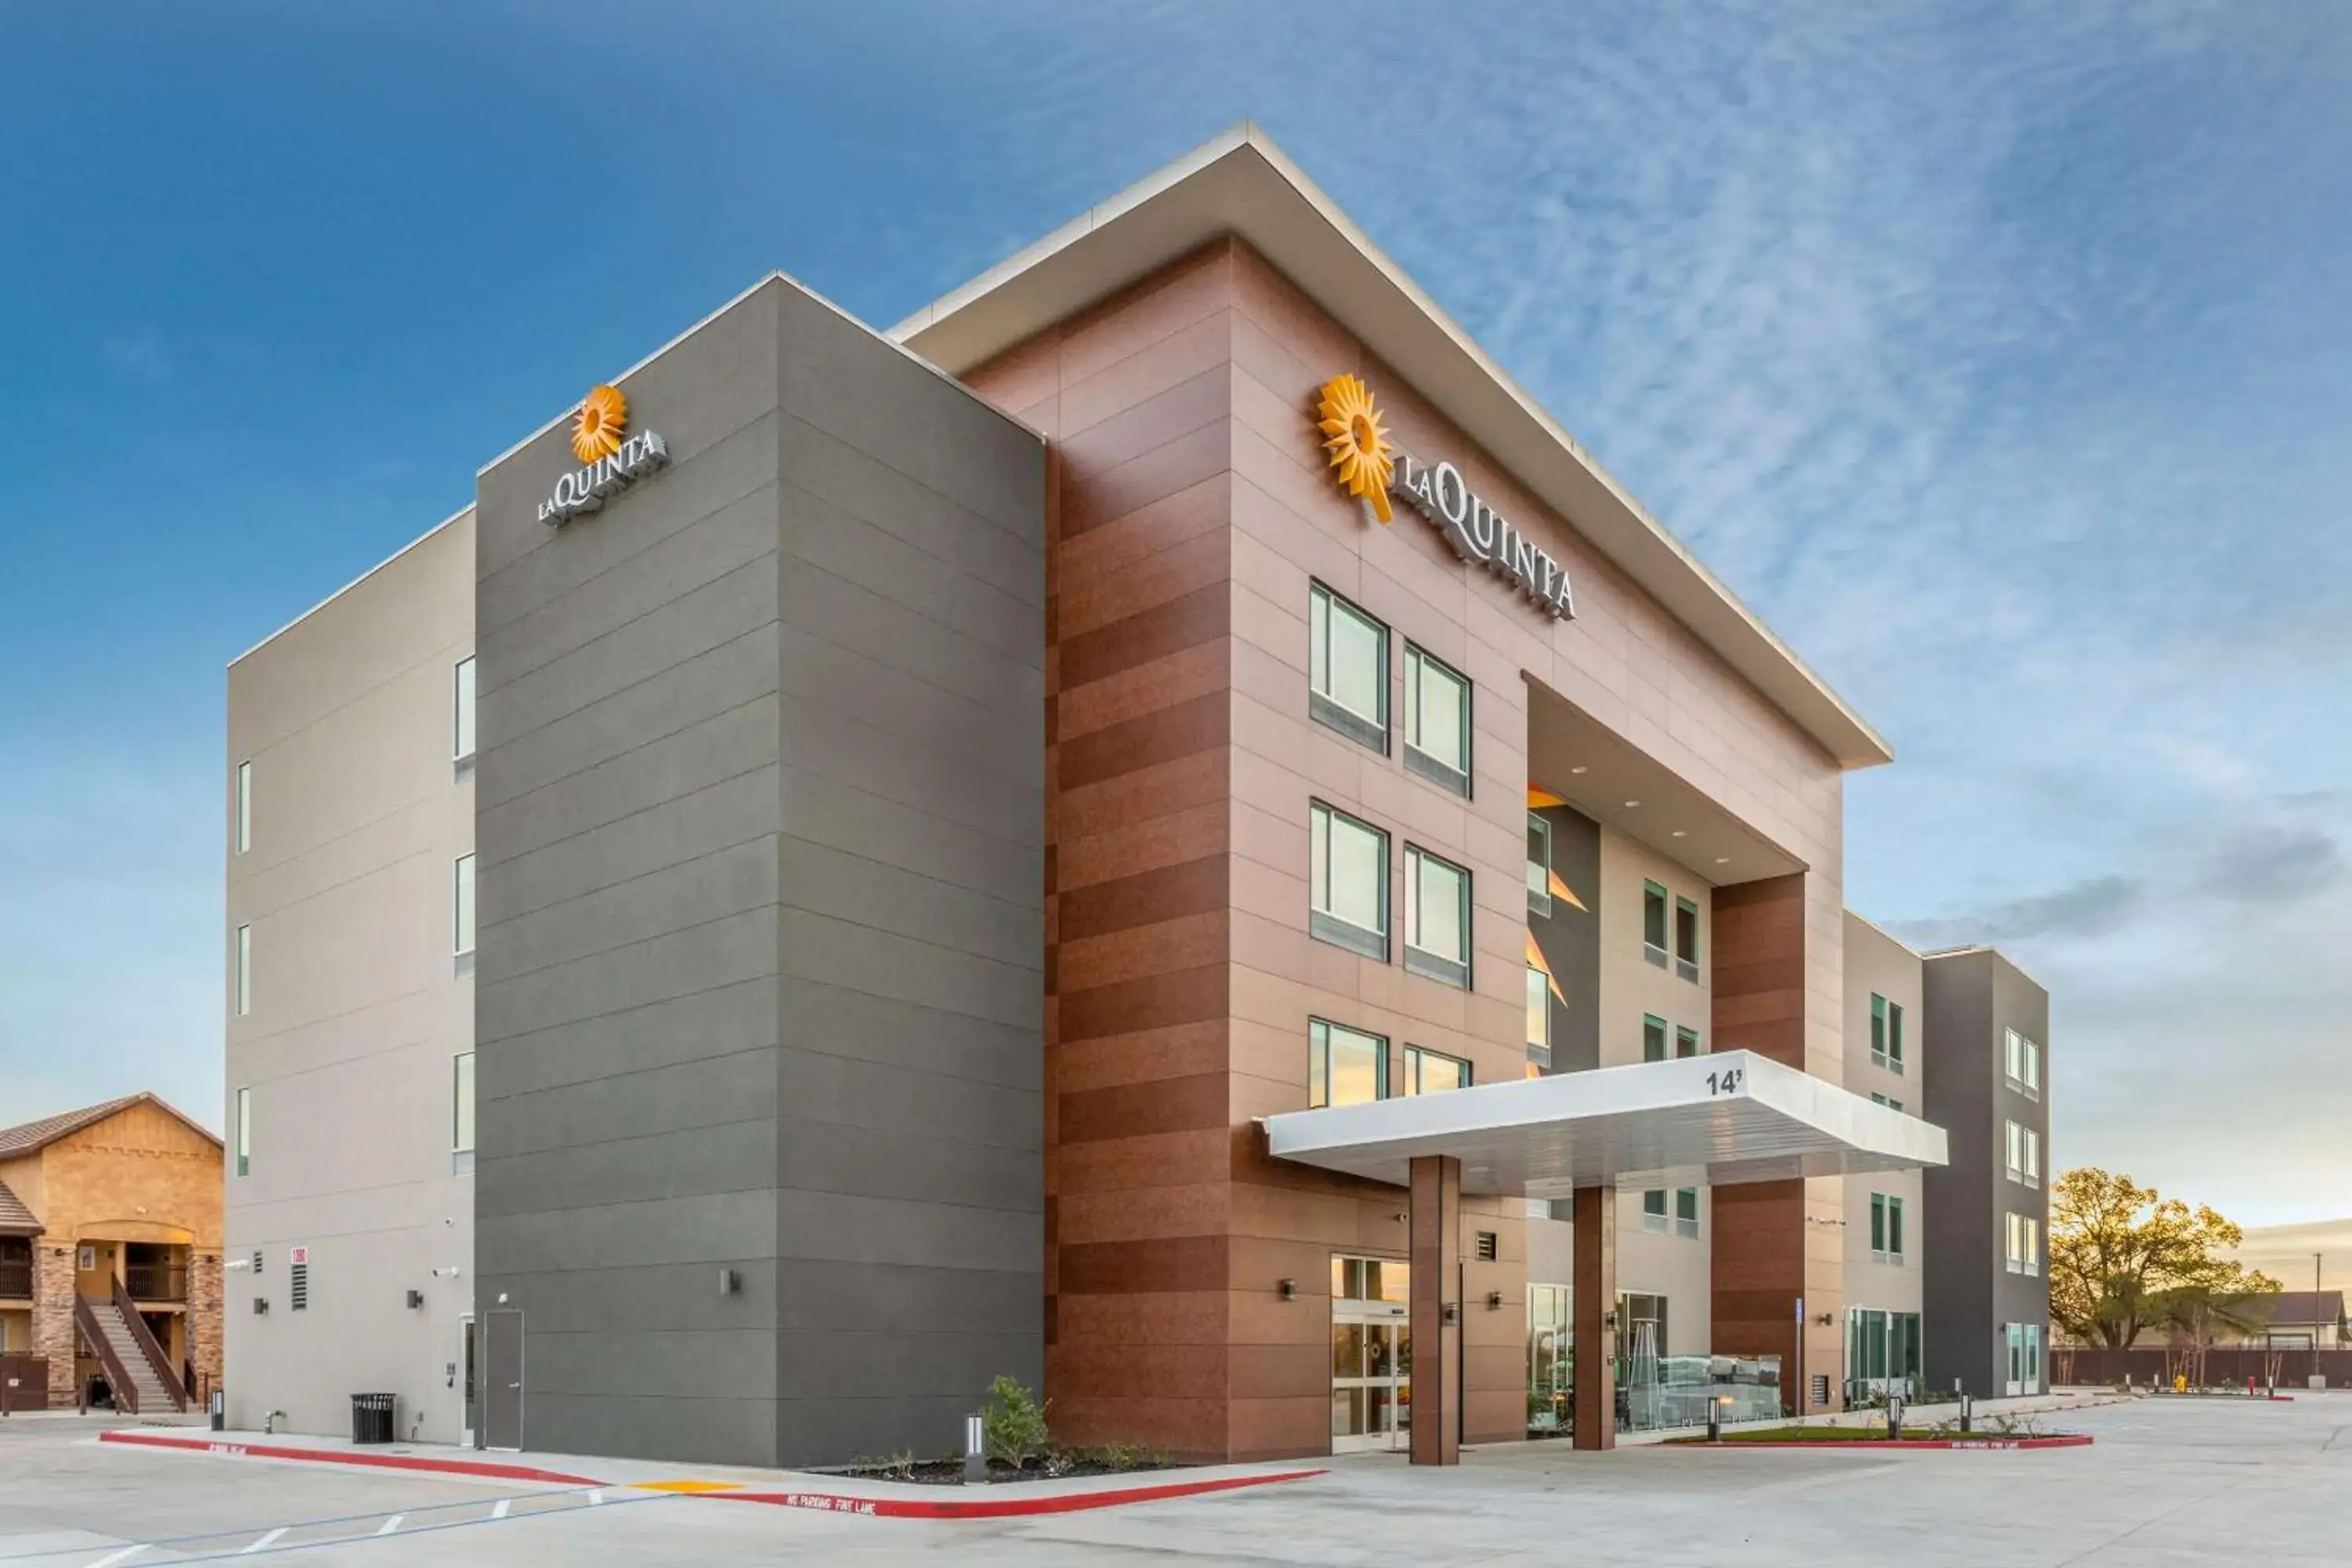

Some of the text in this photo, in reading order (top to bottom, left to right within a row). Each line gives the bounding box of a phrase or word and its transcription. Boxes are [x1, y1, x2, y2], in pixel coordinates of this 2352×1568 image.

[538, 429, 664, 521] LA QUINTA
[1403, 455, 1577, 621] LA QUINTA
